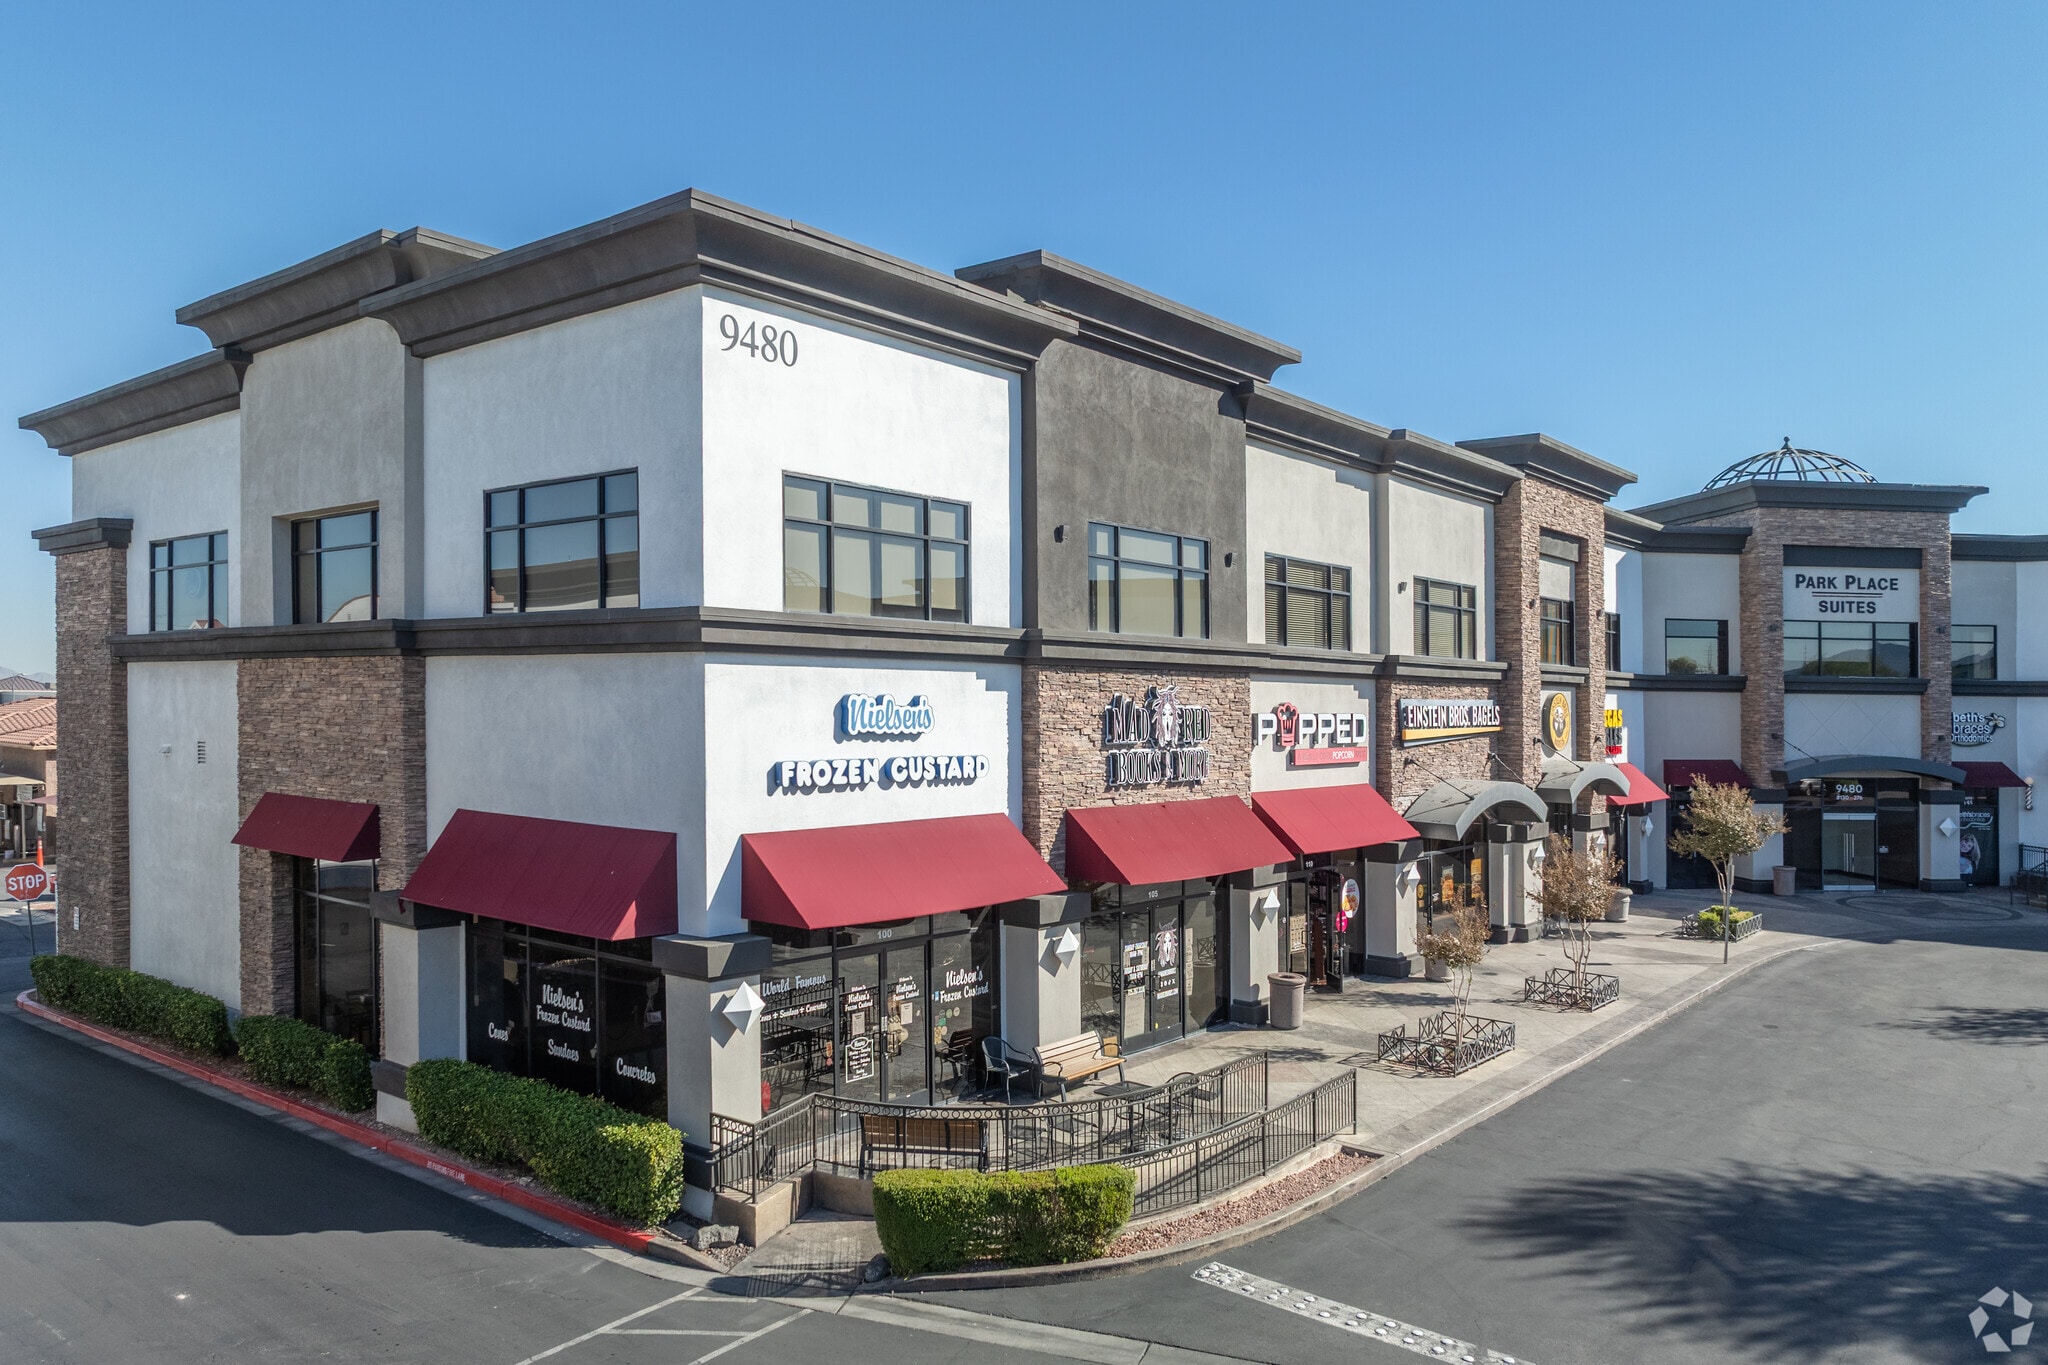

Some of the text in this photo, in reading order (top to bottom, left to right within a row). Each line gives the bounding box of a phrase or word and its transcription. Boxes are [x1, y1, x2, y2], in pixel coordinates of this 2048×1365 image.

[719, 314, 798, 367] 9480
[1795, 573, 1899, 591] PARK PLACE
[1818, 600, 1876, 614] SUITES
[847, 695, 934, 733] Nielsen's
[1408, 705, 1500, 728] EINSTEIN BROS. BAGELS
[1953, 722, 1991, 734] braces
[1332, 750, 1355, 760] POPCORN
[781, 755, 990, 788] FROZEN CUSTARD
[1117, 750, 1161, 784] BOOKS
[1836, 784, 1863, 794] 9480
[1305, 860, 1314, 868] 110
[8, 873, 45, 892] STOP
[877, 929, 892, 939] 100
[762, 974, 827, 997] World Famous
[946, 965, 983, 988] Nielsen's
[542, 984, 584, 1013] Nielsen's
[940, 982, 989, 1003] Frozen Custard
[536, 1004, 591, 1033] Frozen Custard
[488, 1021, 509, 1042] Cones
[547, 1038, 580, 1062] Sundaes
[616, 1057, 656, 1085] Concretes
